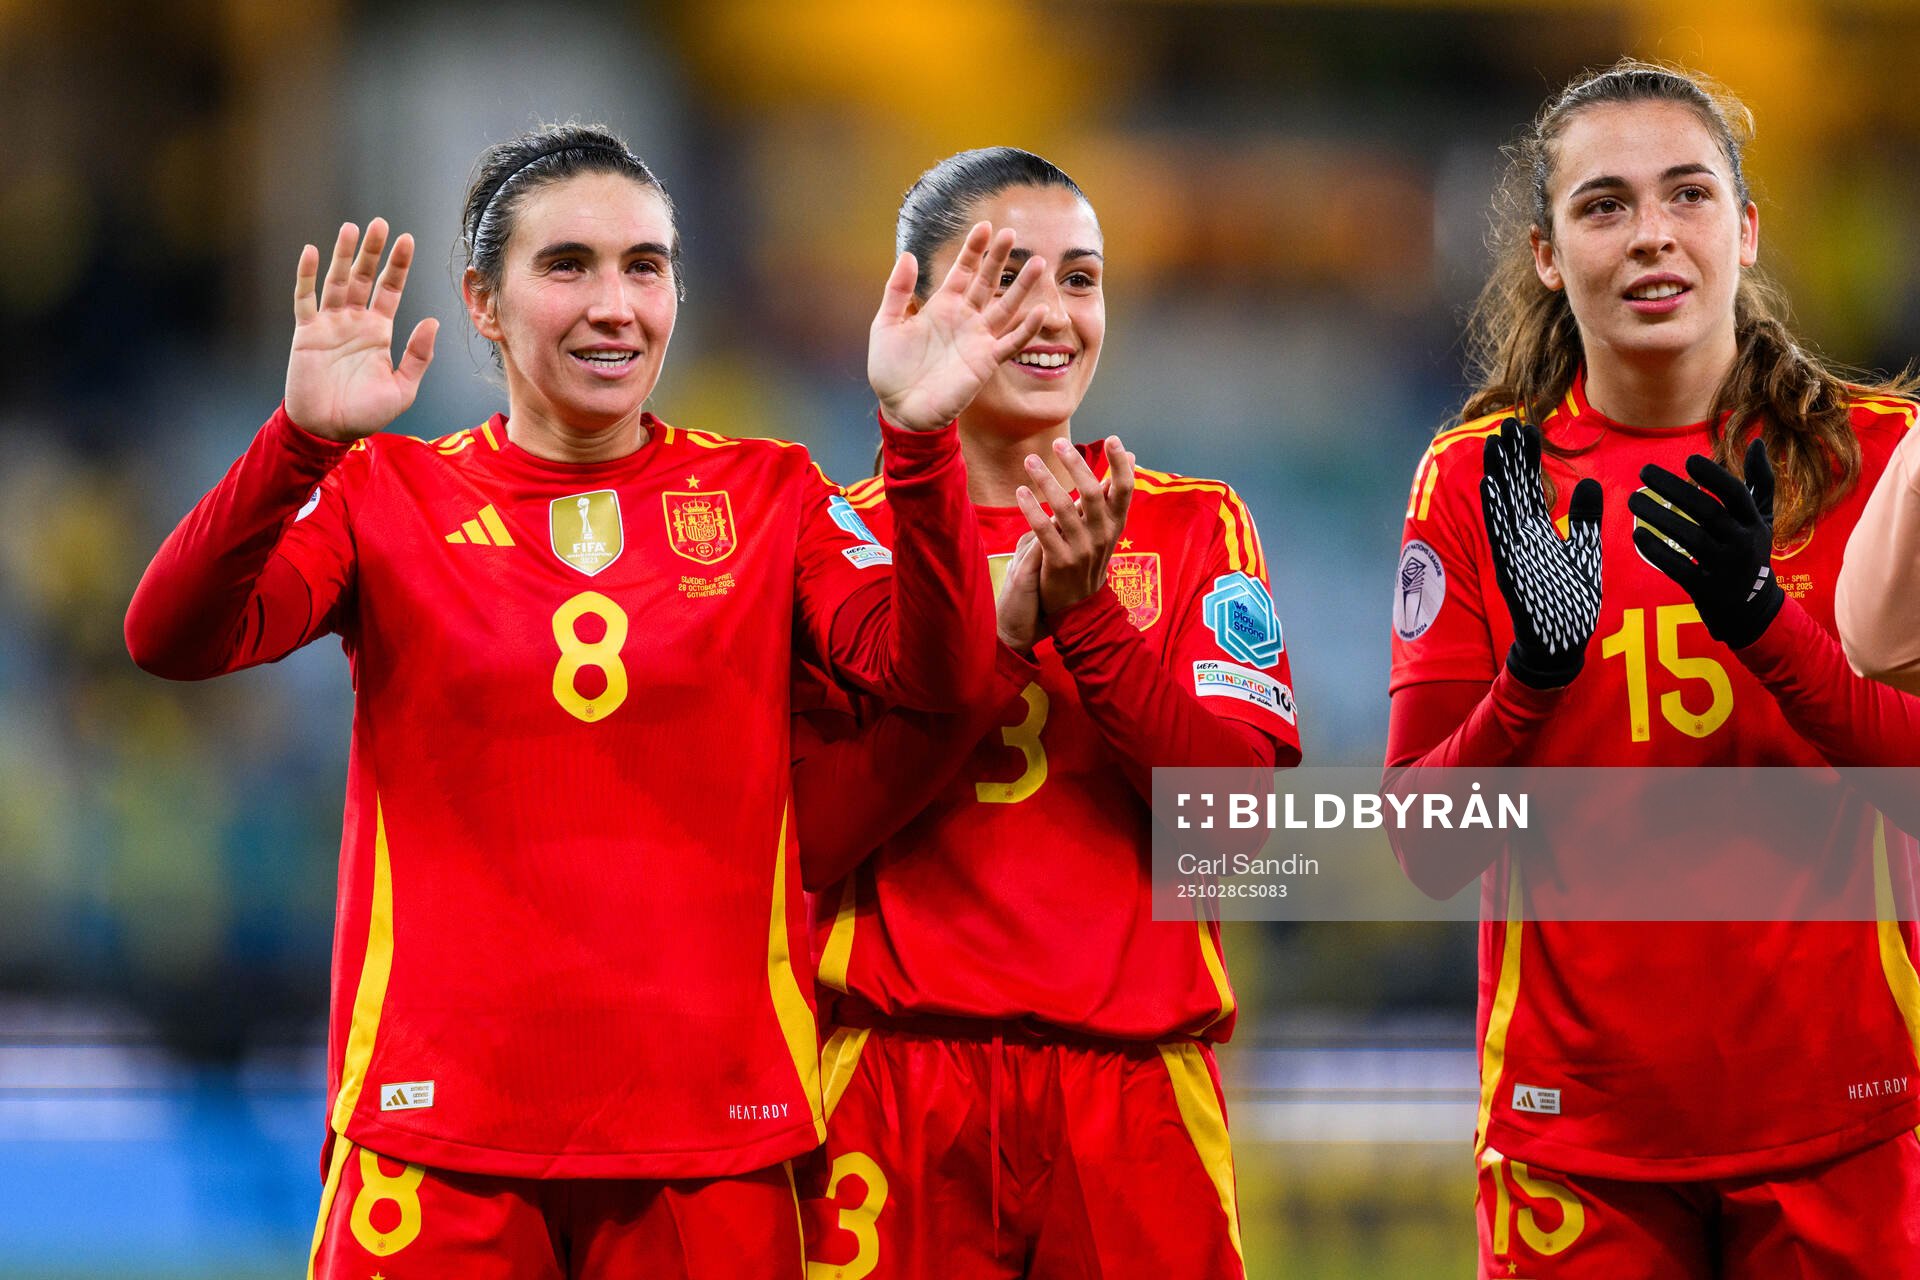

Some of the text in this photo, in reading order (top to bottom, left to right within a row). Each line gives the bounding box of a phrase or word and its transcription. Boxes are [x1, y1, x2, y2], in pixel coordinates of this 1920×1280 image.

[573, 542, 605, 552] FIFA
[686, 587, 728, 599] GOTHENBURG
[688, 583, 717, 592] OCTOBER
[718, 579, 736, 588] 2025
[1796, 581, 1814, 591] 2025
[1234, 601, 1248, 613] We
[1233, 611, 1254, 627] Play
[1233, 621, 1264, 642] Strong
[552, 591, 628, 722] 8
[1602, 603, 1734, 742] 15
[1197, 673, 1272, 697] FOUNDATION
[975, 681, 1049, 804] 3
[1848, 1076, 1908, 1100] HEAT.RDY
[729, 1103, 788, 1120] HEAT.RDY
[349, 1147, 426, 1257] 8
[1481, 1146, 1585, 1256] 15
[807, 1151, 889, 1280] 3
